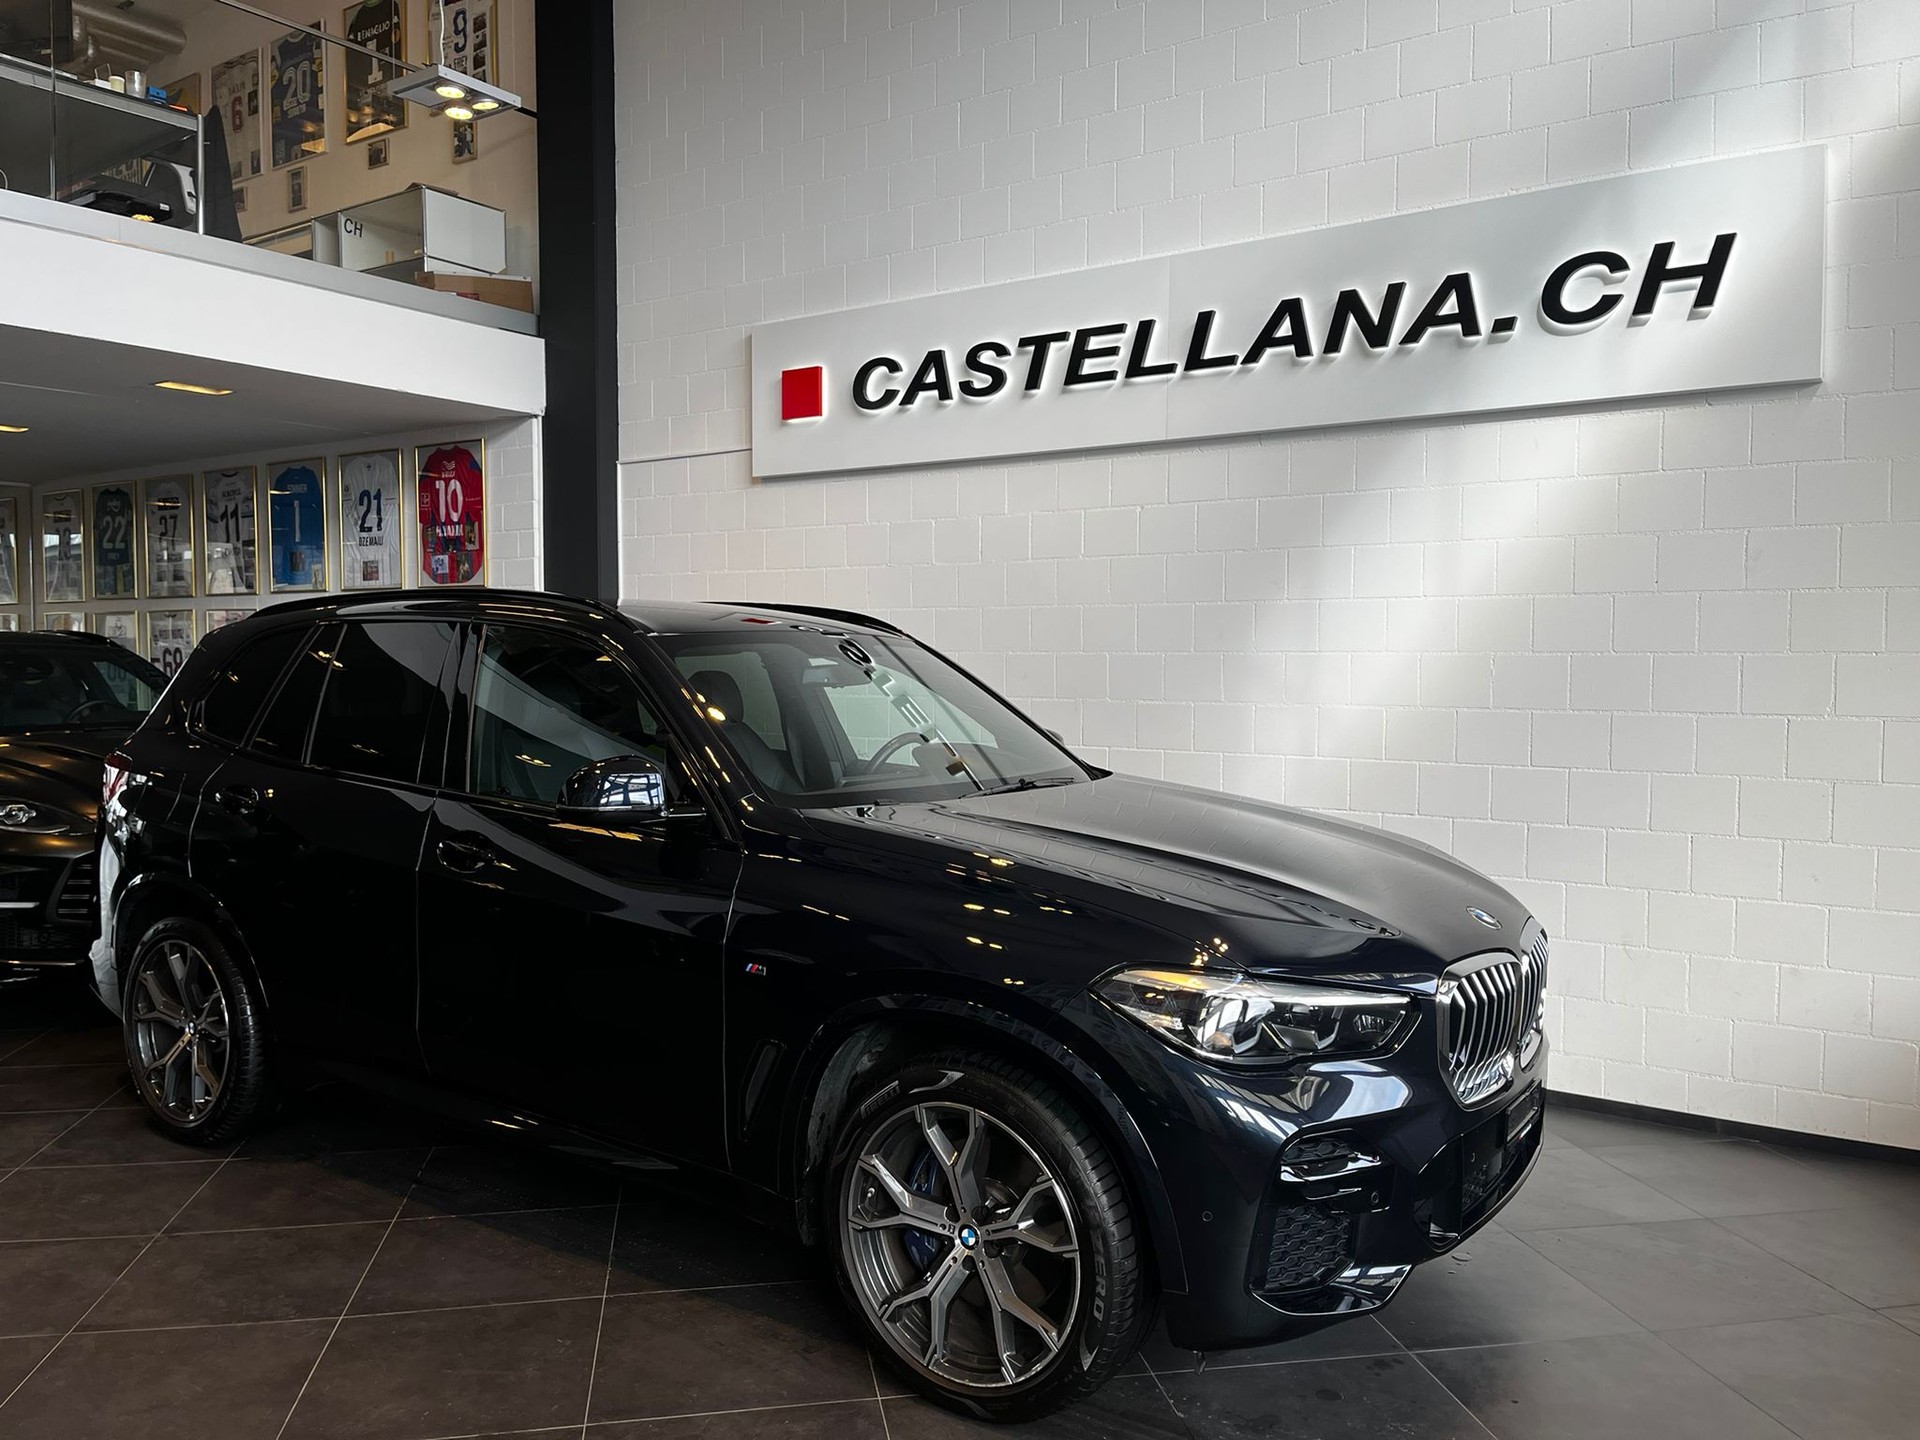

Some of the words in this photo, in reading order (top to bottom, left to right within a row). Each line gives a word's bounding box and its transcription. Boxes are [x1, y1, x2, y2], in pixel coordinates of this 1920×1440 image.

[453, 8, 468, 53] 9
[365, 38, 384, 85] 1
[282, 60, 311, 111] 20
[344, 218, 364, 239] CH
[852, 232, 1737, 409] CASTELLANA.CH
[358, 488, 383, 533] 21
[434, 478, 464, 522] 10
[102, 515, 127, 549] 22
[220, 504, 241, 544] 11
